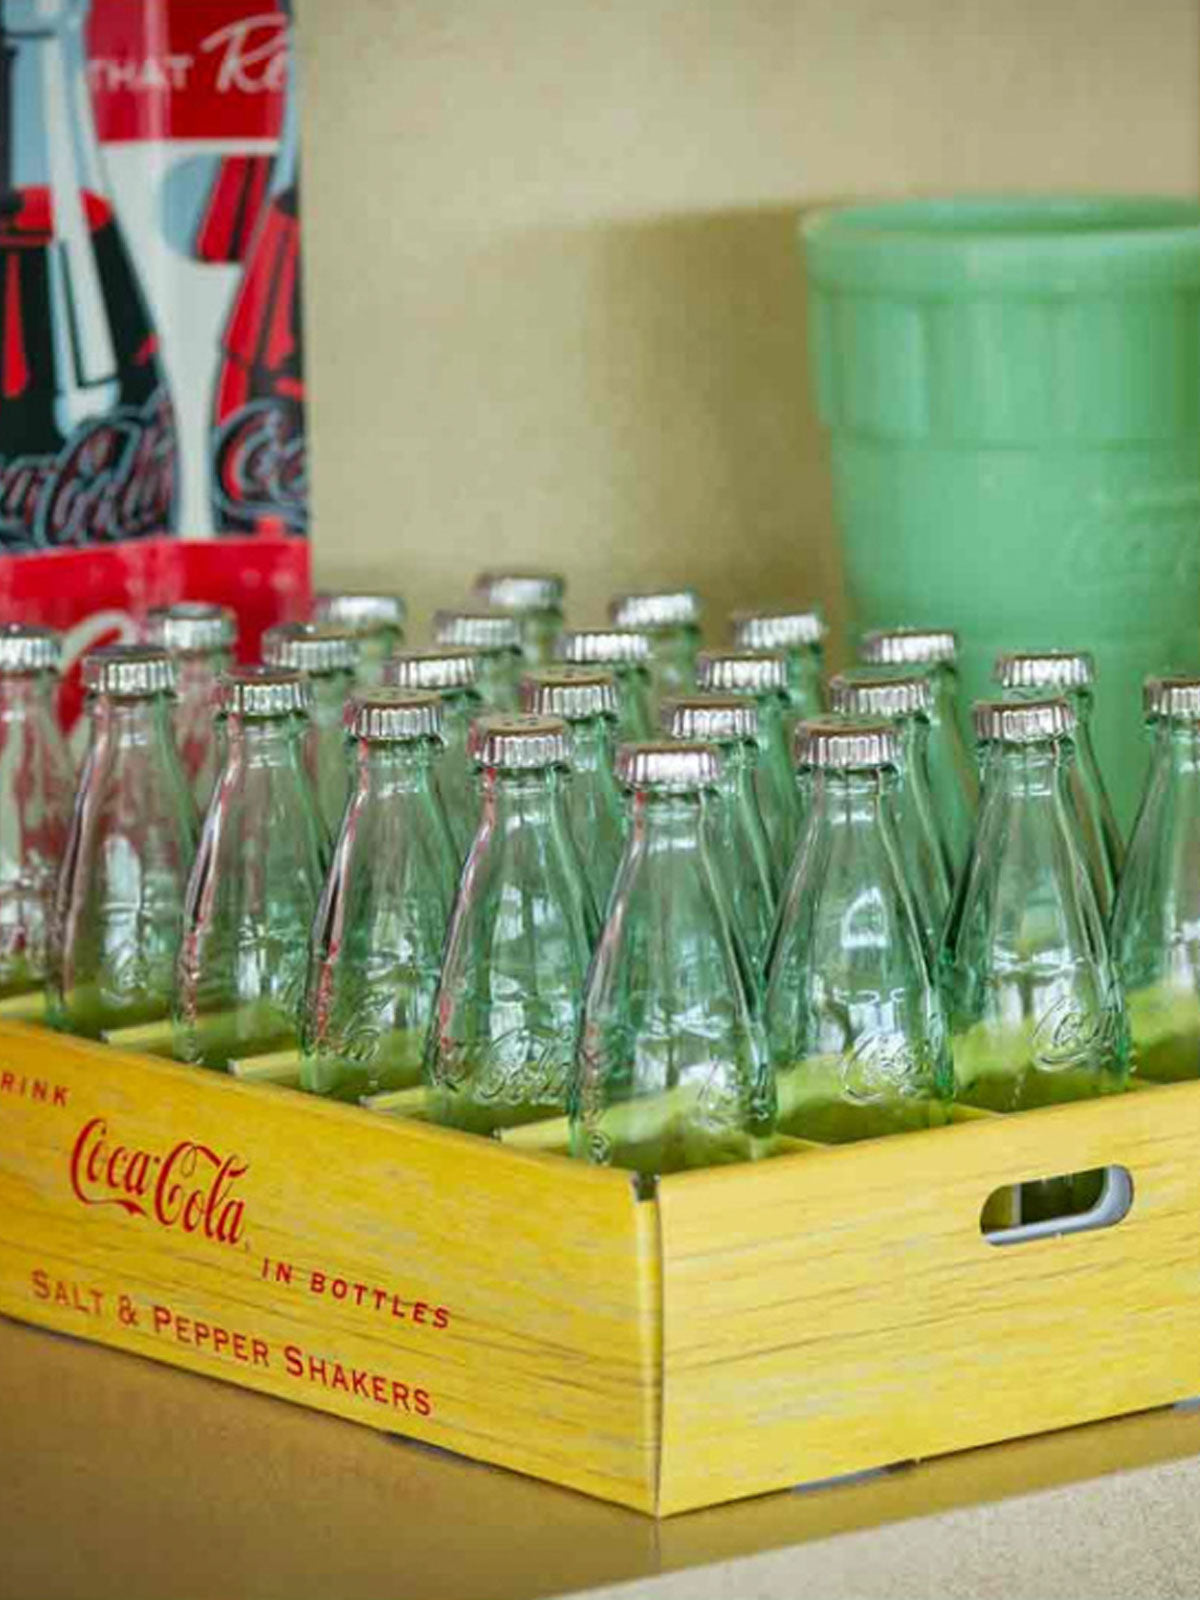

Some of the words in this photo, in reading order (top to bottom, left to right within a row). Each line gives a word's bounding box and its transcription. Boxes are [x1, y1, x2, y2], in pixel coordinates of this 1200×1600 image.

[87, 55, 194, 91] THAT
[70, 1117, 250, 1247] Coca-Cola
[31, 1268, 105, 1319] SALT
[117, 1295, 140, 1328] &
[152, 1303, 272, 1369] PEPPER
[283, 1344, 434, 1417] SHAKERS
[261, 1257, 294, 1284] IN
[310, 1271, 452, 1330] BOTTLES
